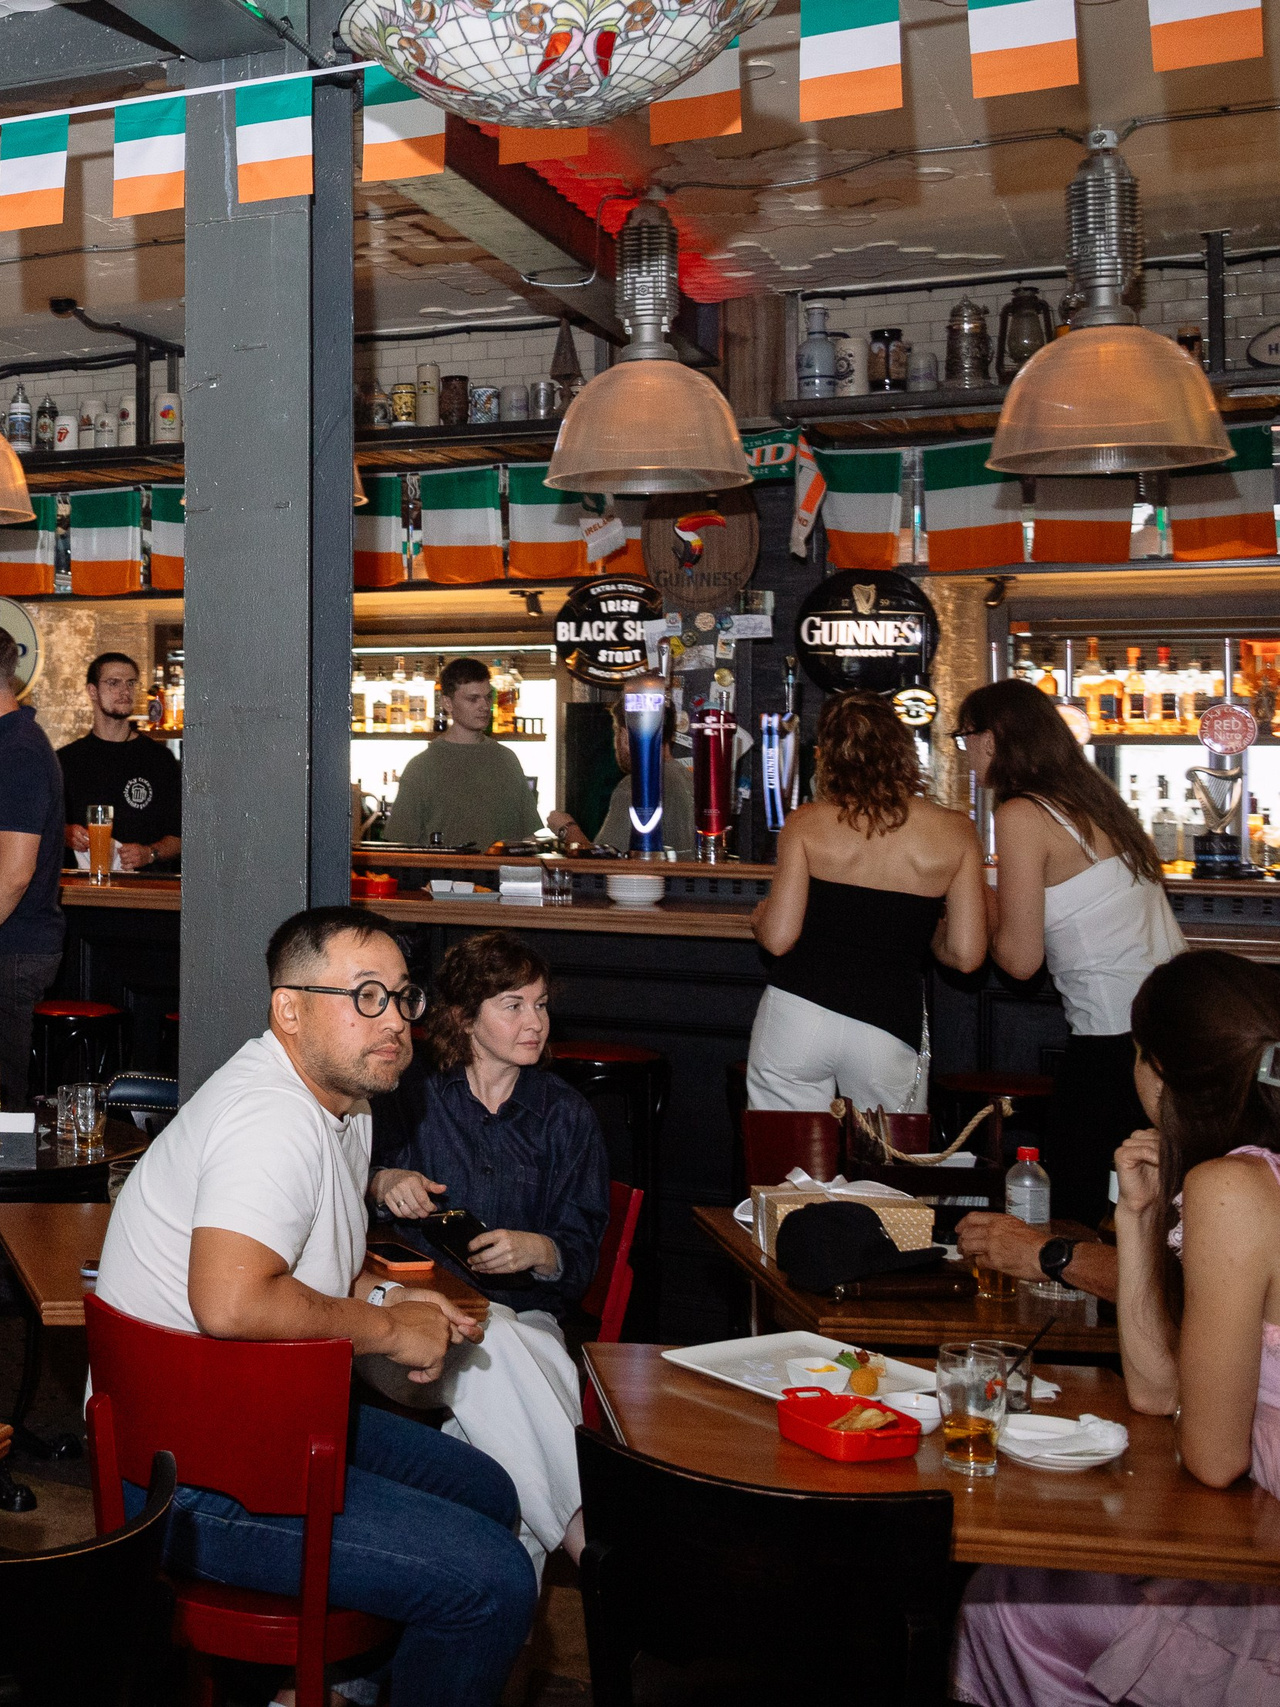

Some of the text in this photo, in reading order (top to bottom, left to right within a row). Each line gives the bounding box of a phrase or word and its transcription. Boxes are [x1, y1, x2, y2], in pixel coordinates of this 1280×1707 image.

[655, 570, 742, 588] GUINNESS
[589, 583, 646, 595] EXTRA STOUT
[600, 599, 640, 614] IRISH
[556, 620, 619, 642] BLACK
[597, 649, 642, 664] STOUT
[834, 648, 896, 657] DRAUGHT
[1214, 719, 1242, 731] RED
[1214, 730, 1243, 741] Nitro
